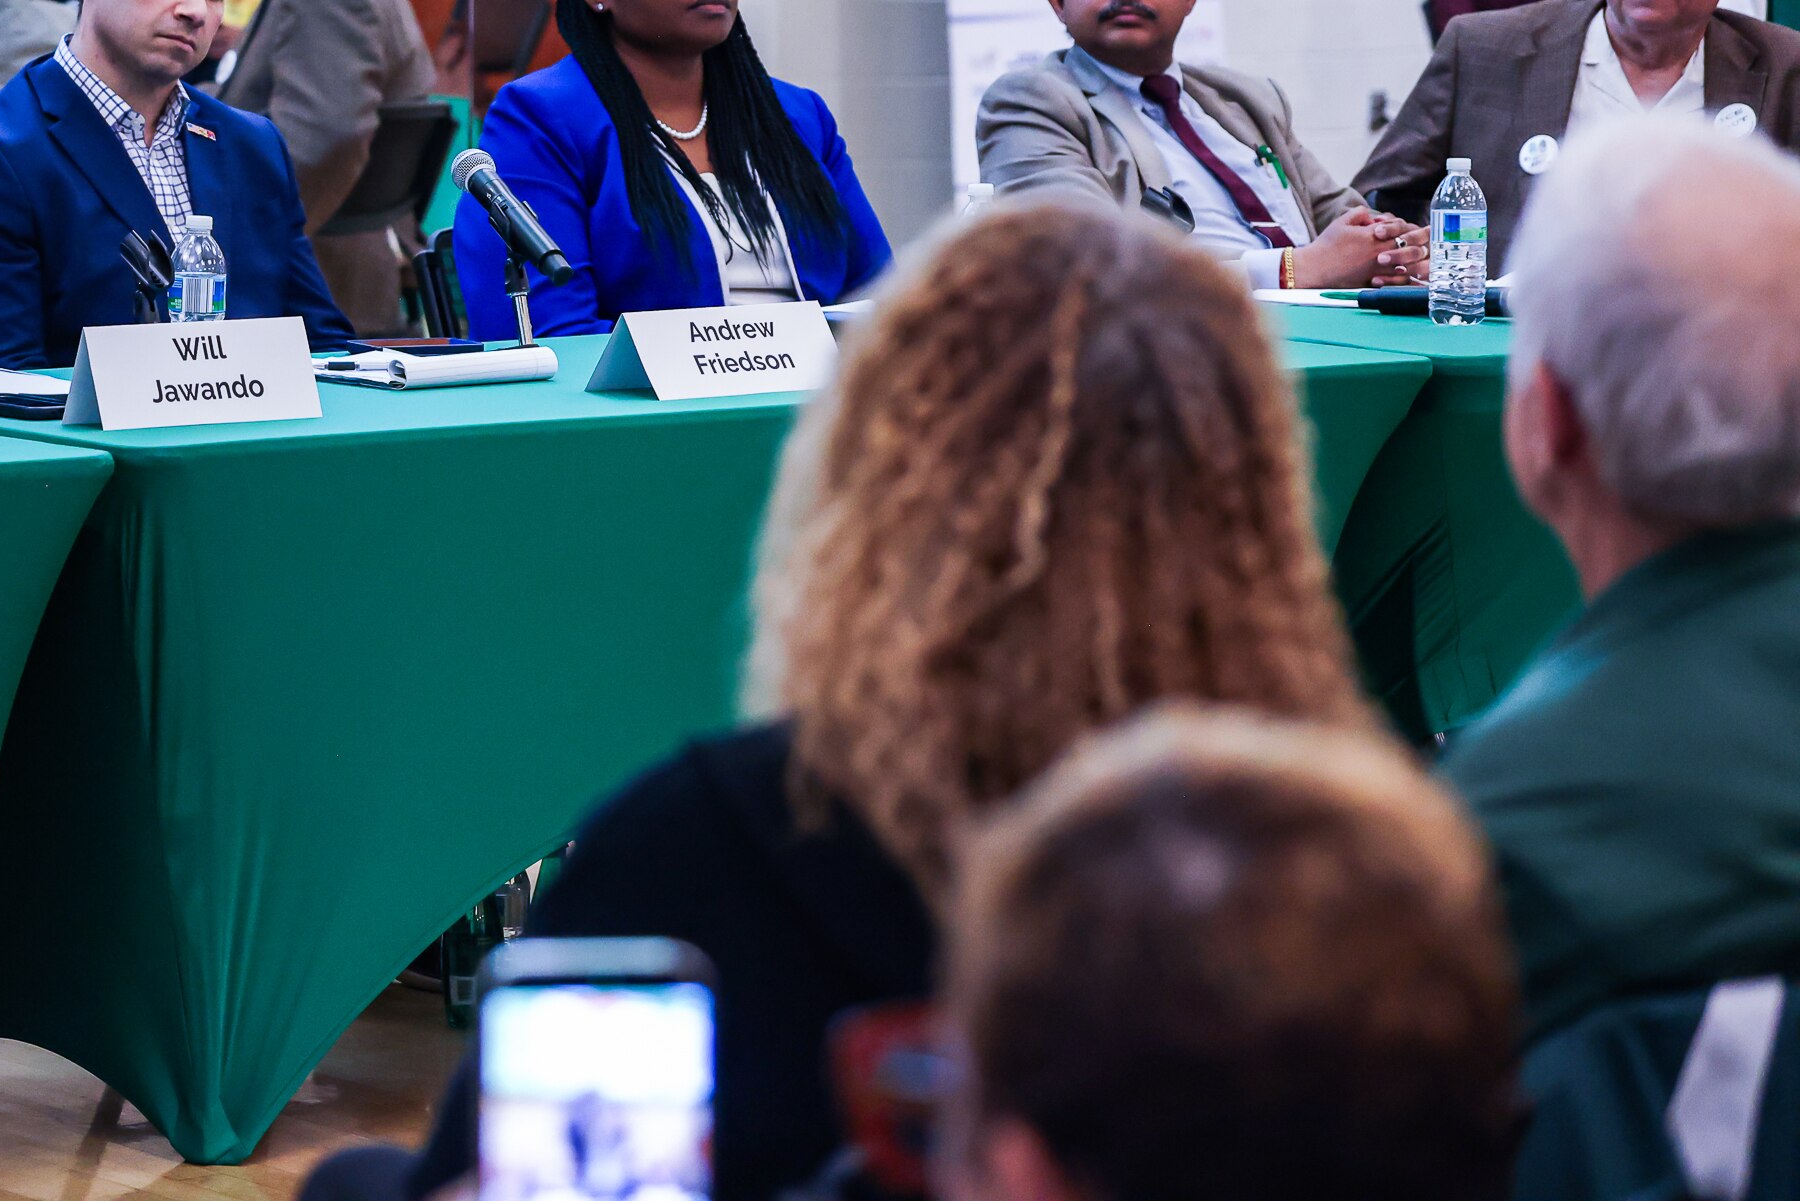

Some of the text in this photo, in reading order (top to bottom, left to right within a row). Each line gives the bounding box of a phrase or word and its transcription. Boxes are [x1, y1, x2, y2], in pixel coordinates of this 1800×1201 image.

[689, 318, 774, 343] Andrew
[171, 334, 228, 362] Will
[693, 349, 796, 375] Friedson
[152, 373, 265, 405] Jawando
